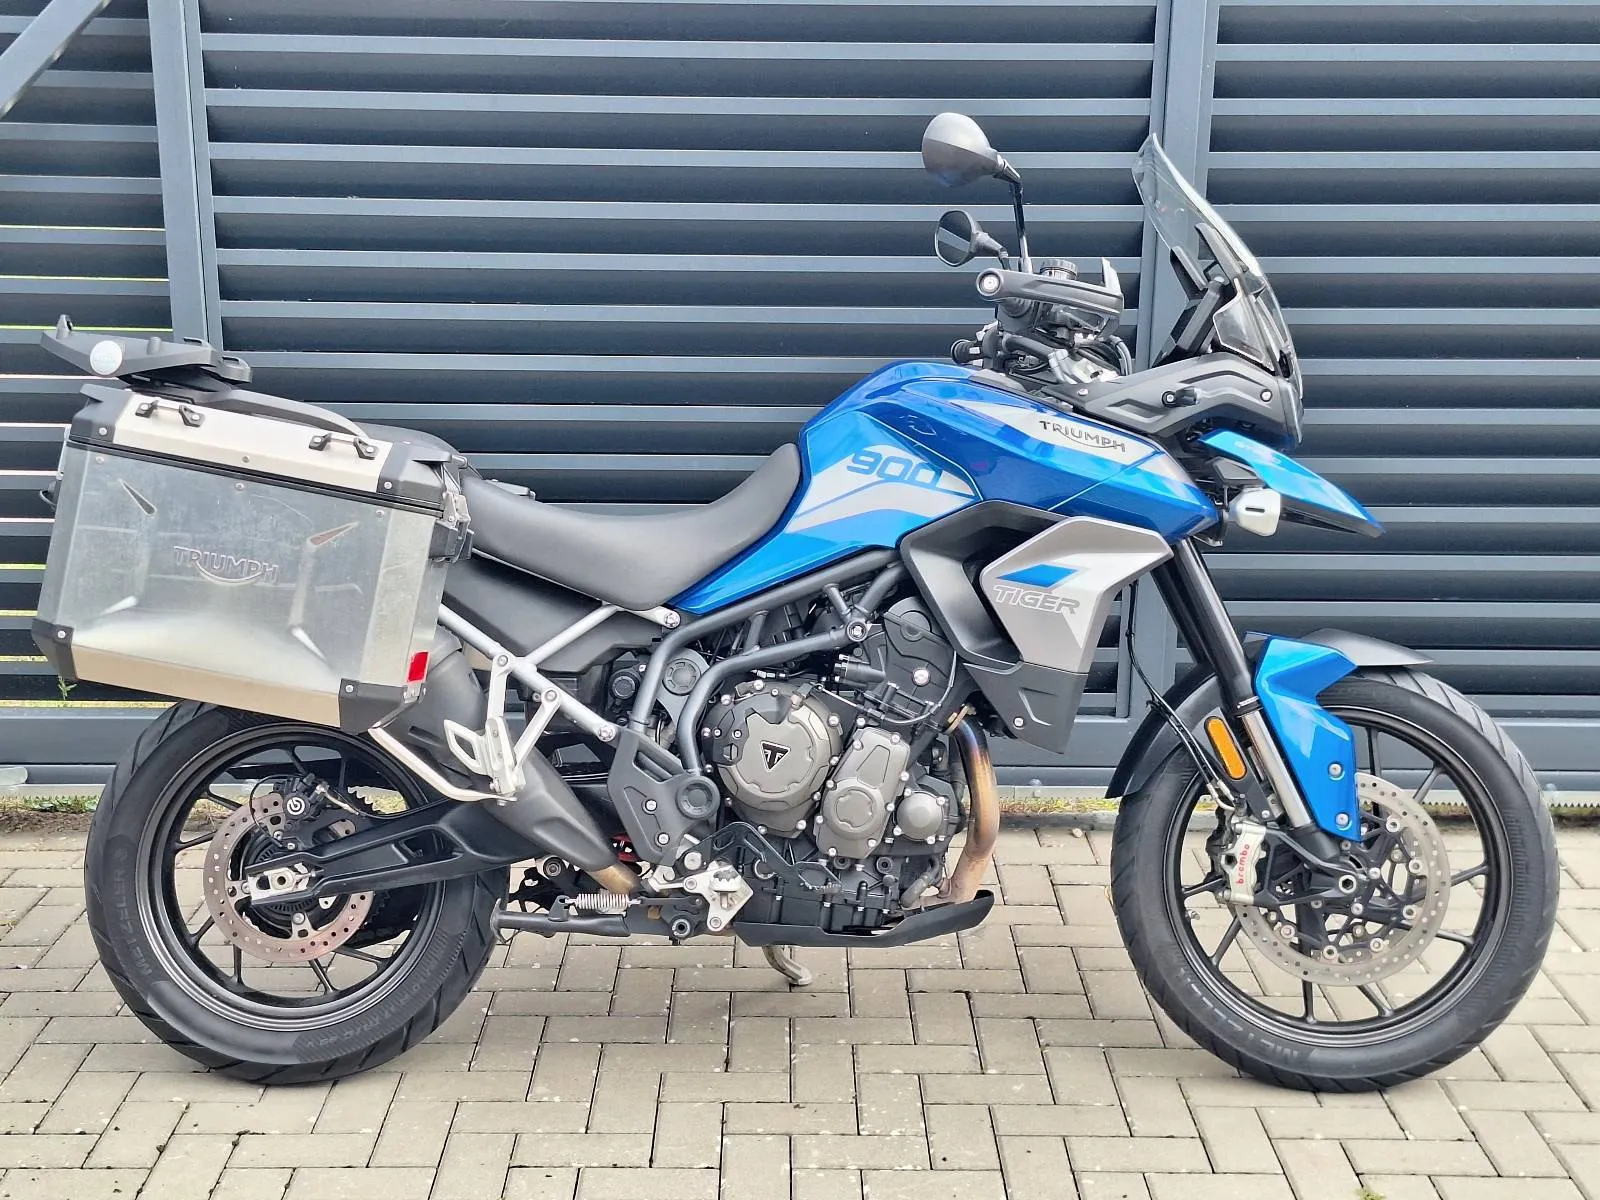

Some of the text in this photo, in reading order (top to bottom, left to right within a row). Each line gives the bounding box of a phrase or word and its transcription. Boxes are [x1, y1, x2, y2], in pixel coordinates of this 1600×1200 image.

[1039, 420, 1126, 453] TRIUMPH
[847, 450, 942, 489] 900
[173, 545, 279, 585] TRIUMPH
[993, 584, 1081, 614] TIGER
[1236, 844, 1250, 884] brembo
